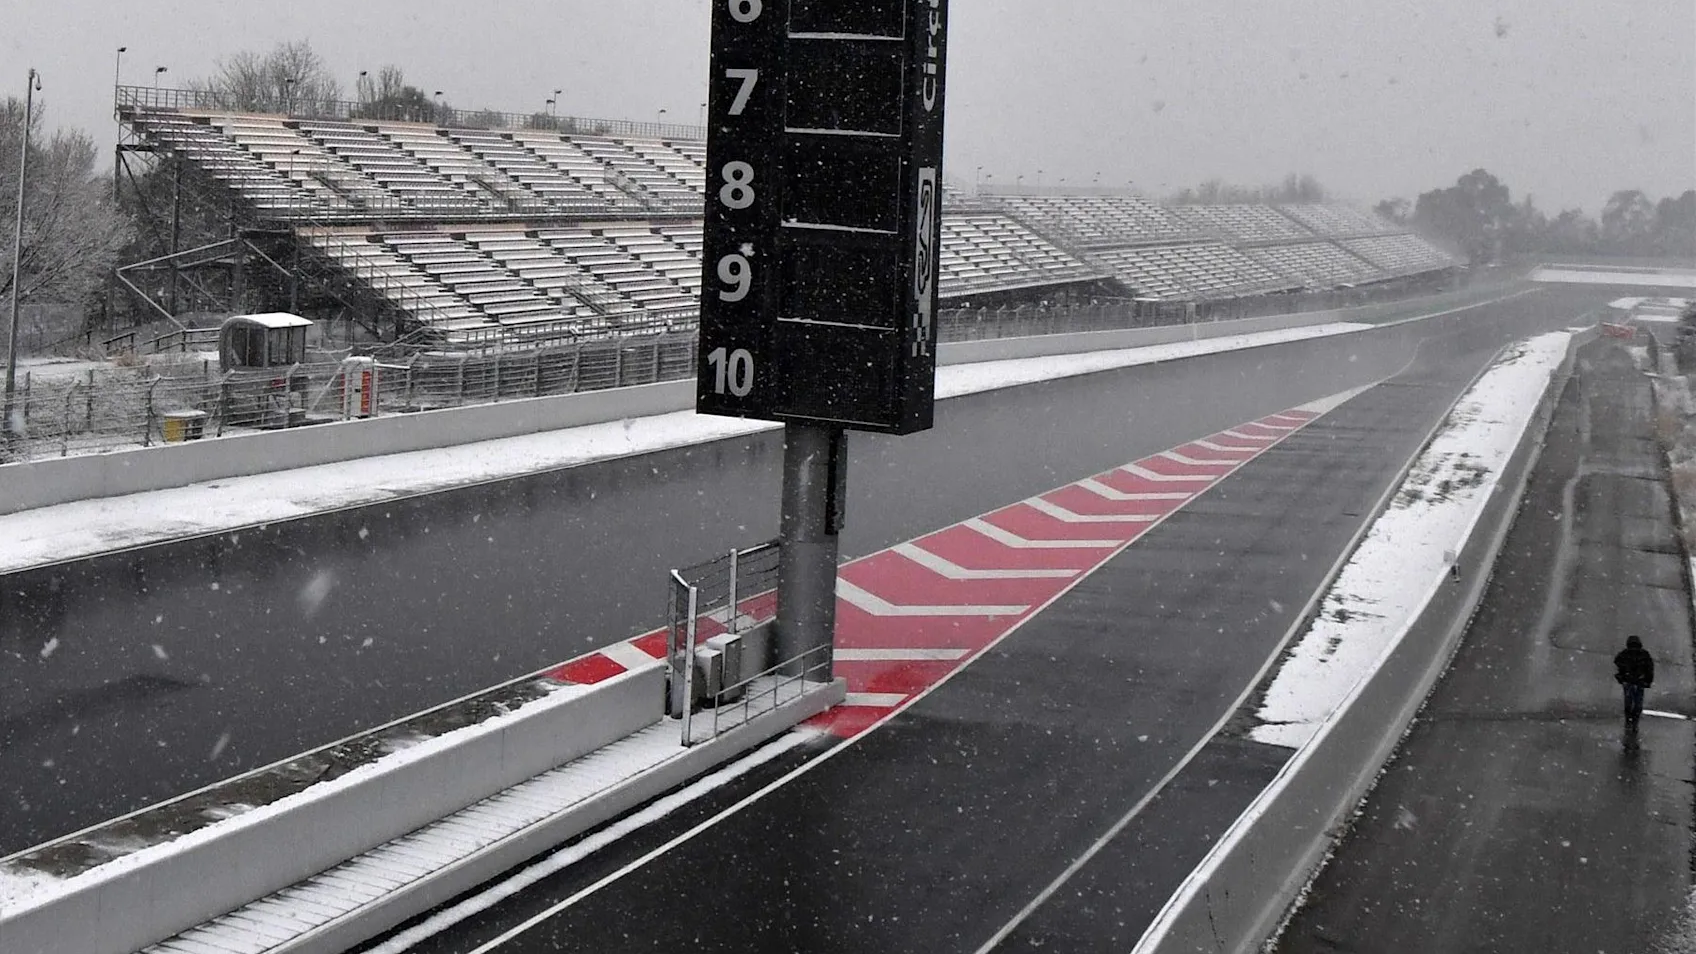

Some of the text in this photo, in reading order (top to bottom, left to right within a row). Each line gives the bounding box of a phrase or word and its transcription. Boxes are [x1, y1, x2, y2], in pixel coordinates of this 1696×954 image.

[725, 68, 759, 116] 7
[719, 160, 755, 210] 8
[716, 253, 752, 303] 9
[707, 347, 754, 398] 10
